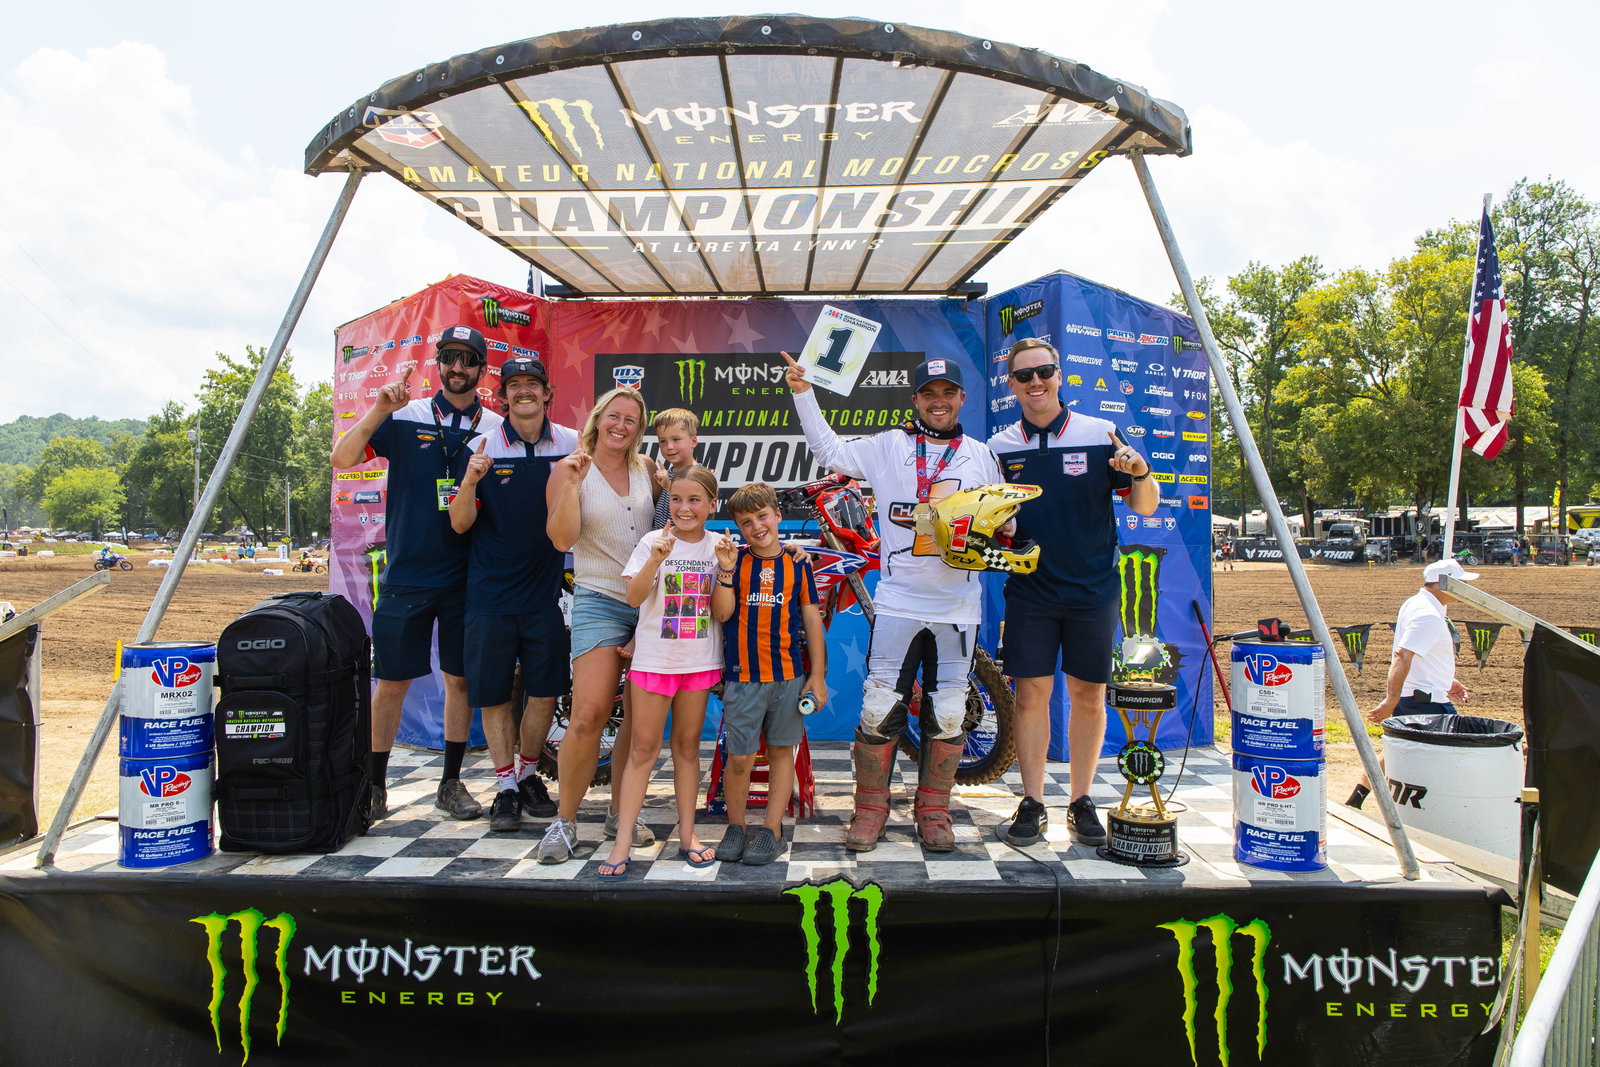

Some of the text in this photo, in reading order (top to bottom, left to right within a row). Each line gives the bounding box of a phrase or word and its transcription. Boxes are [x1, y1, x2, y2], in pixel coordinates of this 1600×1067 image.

[620, 99, 922, 131] MONSTER
[992, 99, 1119, 124] AMA
[675, 131, 875, 145] ENERGY
[403, 150, 1109, 183] AMATEUR NATIONAL MOTOCROSS
[633, 237, 884, 253] AT LORETTA LYNN'S
[498, 308, 531, 322] MONSTER
[1013, 301, 1042, 317] MONSTER
[843, 318, 876, 332] CHAMPION
[1107, 328, 1134, 338] PARTS
[1138, 334, 1169, 345] AMSOIL
[486, 338, 508, 352] SOIL
[512, 346, 540, 357] PARTS
[815, 327, 855, 375] 1
[1066, 354, 1103, 366] PROGRESSIVE
[714, 362, 789, 385] MONS
[859, 370, 910, 386] AMA
[1182, 369, 1206, 380] THOR
[344, 392, 358, 400] FOX
[732, 387, 795, 395] ENER
[1191, 392, 1207, 400] FOX
[1100, 403, 1124, 411] COMETIC
[701, 410, 790, 426] NATIONAL
[915, 420, 940, 437] OAKLEY
[1152, 452, 1176, 460] OGIO
[950, 515, 974, 554] 1
[952, 554, 977, 565] FLY
[1258, 550, 1283, 558] THO
[1323, 550, 1355, 560] THOR
[665, 560, 714, 568] DESCENDANTS
[746, 592, 776, 602] utilita
[236, 638, 286, 650] OGIO
[152, 656, 190, 688] VP
[1244, 654, 1278, 686] VP
[1266, 670, 1293, 683] Racing
[176, 671, 202, 684] Racing
[1117, 695, 1163, 704] CHAMPION
[180, 718, 205, 727] FUEL
[235, 724, 275, 733] CHAMPION
[1240, 718, 1299, 729] RACE FUEL
[140, 765, 177, 797] VP
[164, 780, 191, 794] Racing
[1251, 765, 1286, 798] VP
[1274, 784, 1300, 796] Racing
[134, 826, 196, 839] RACE FUEL
[1246, 828, 1306, 842] RACE FUEL
[1112, 838, 1171, 854] CHAMPIONSHIP
[303, 938, 542, 984] MONSTER
[1281, 947, 1501, 994] MONSTE
[341, 991, 503, 1006] ENERGY
[1326, 1002, 1495, 1018] ENERGY
